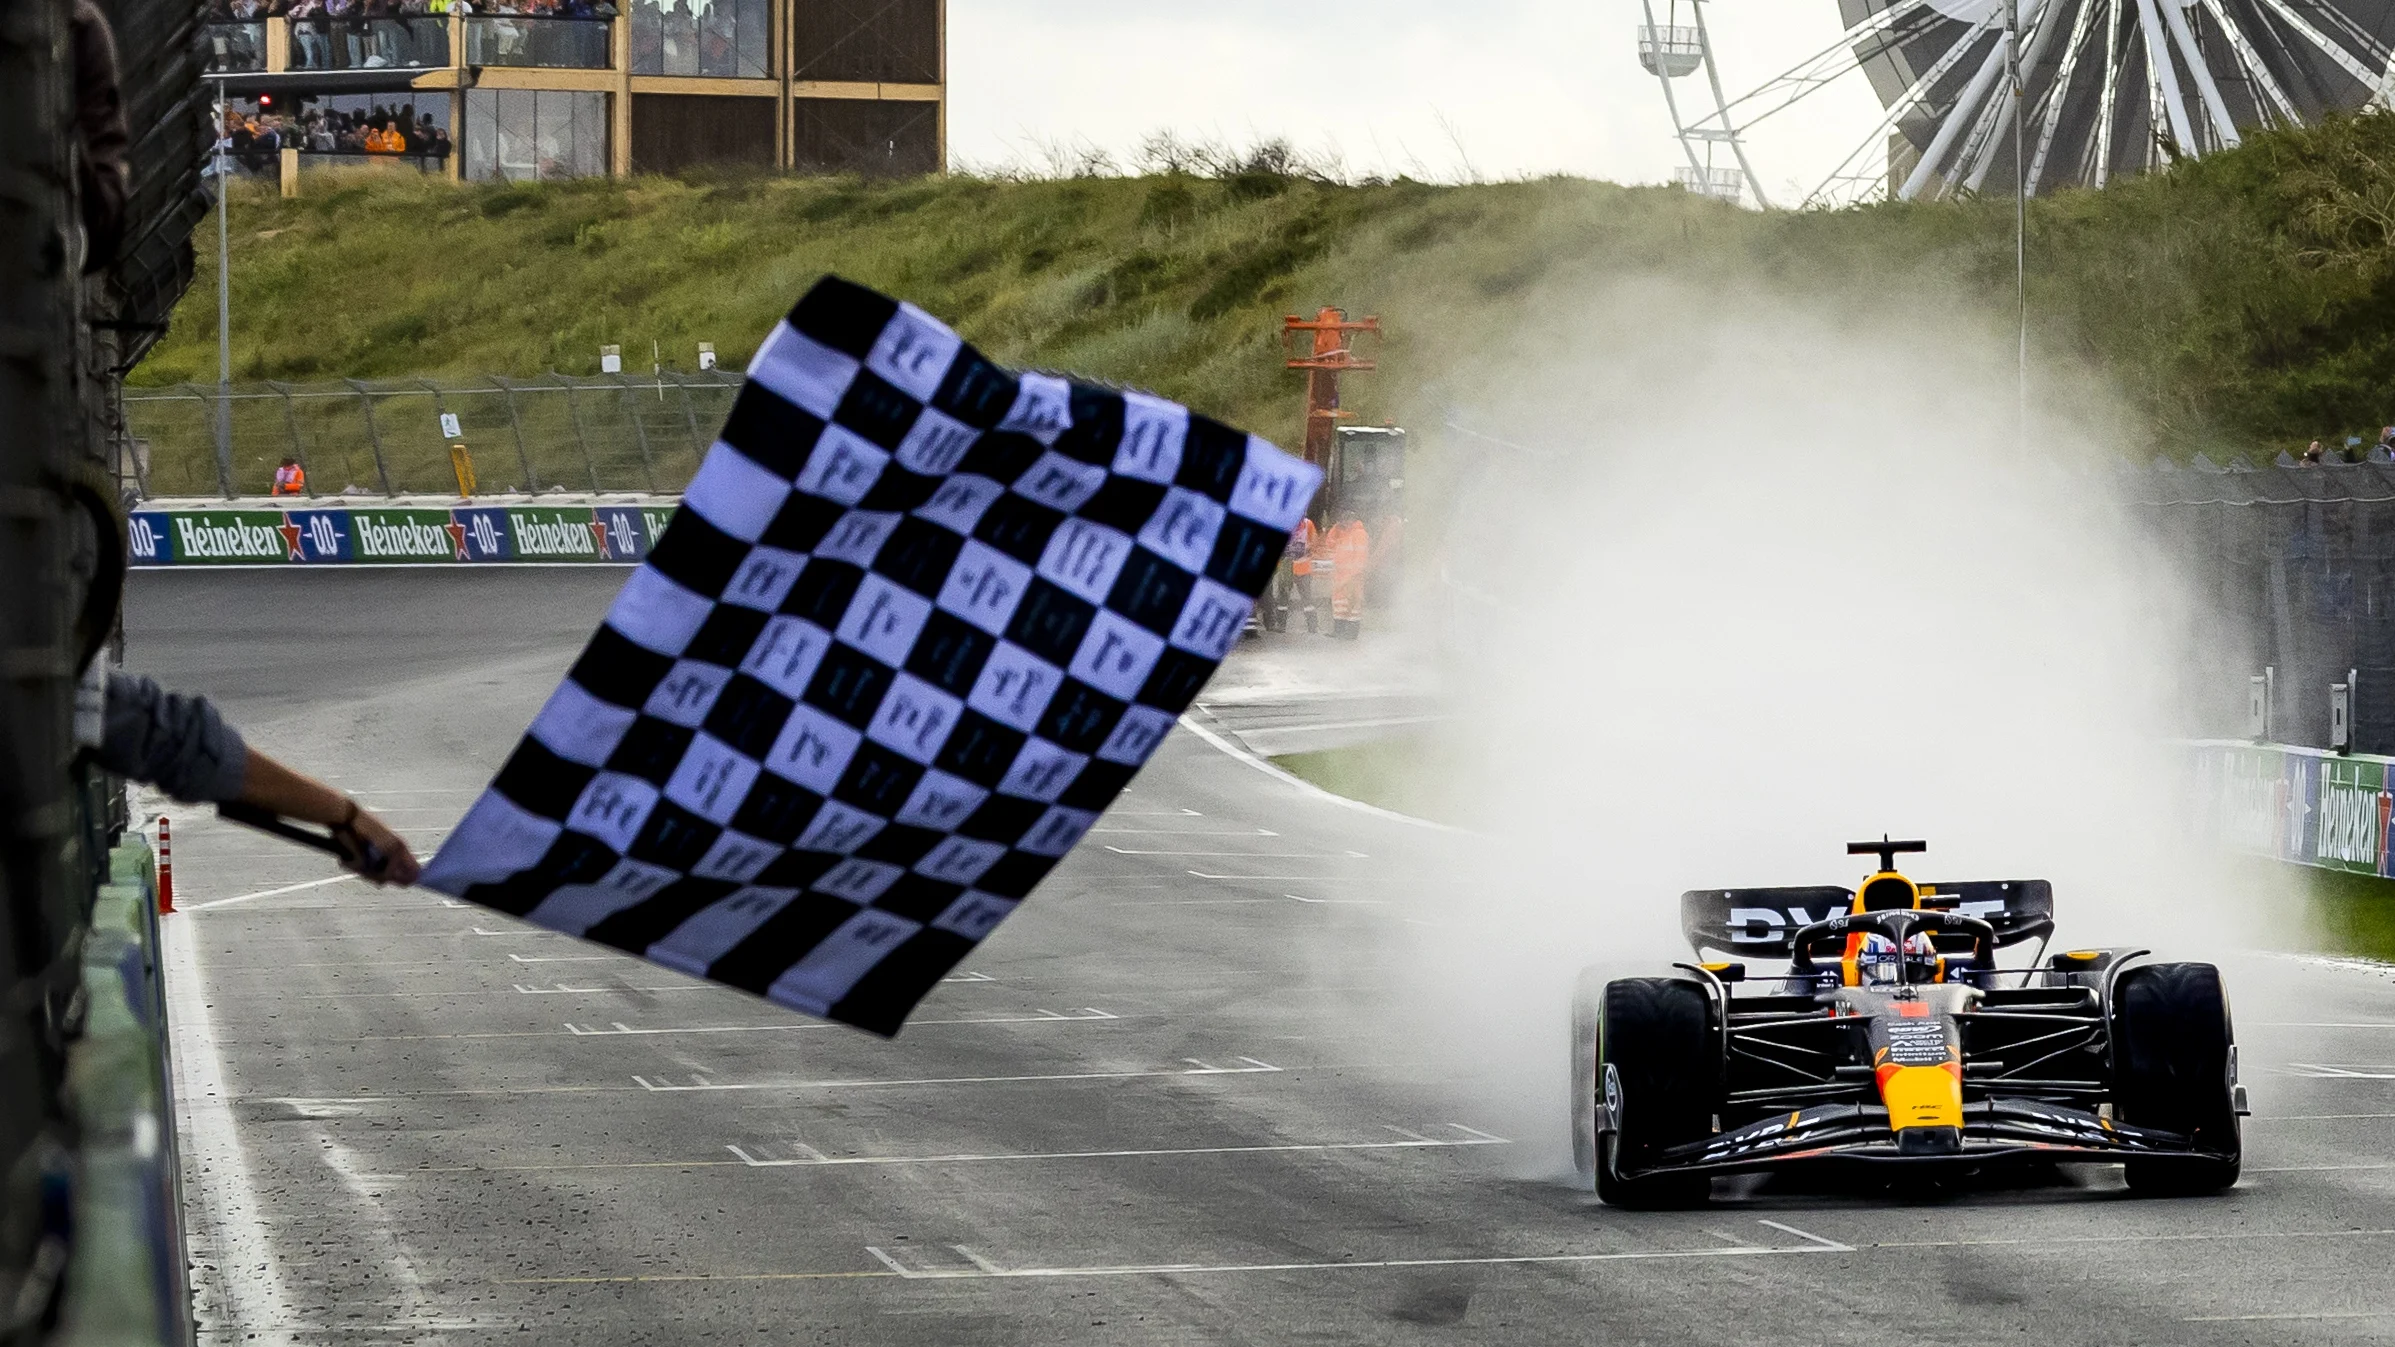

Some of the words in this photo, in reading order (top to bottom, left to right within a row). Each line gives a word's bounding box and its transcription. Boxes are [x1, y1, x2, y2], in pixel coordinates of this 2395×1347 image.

[175, 516, 281, 557] Heineken
[354, 515, 450, 556] Heineken
[510, 513, 595, 555] Heineken
[2318, 762, 2377, 864] Heineken
